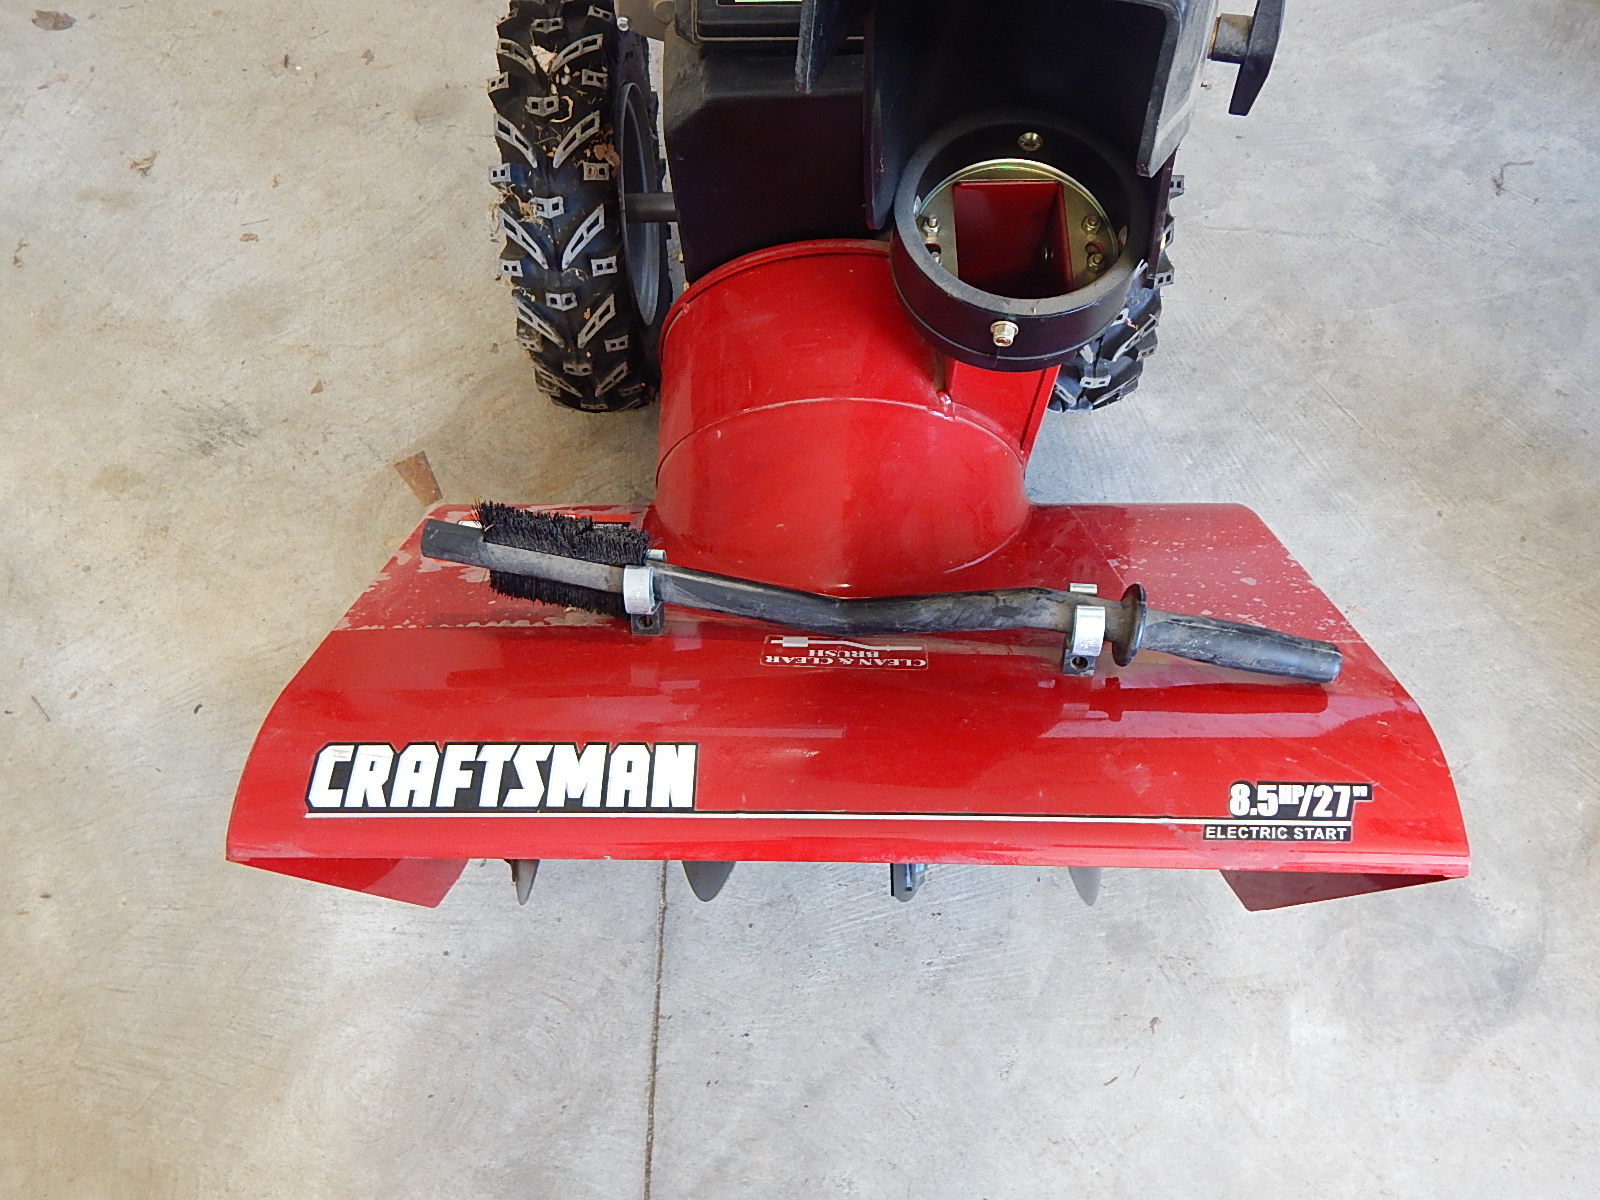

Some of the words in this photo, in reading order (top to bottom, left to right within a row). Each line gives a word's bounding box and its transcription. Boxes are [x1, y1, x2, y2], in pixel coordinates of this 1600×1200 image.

[808, 649, 879, 658] BRUSH
[765, 655, 834, 665] CLEAR
[839, 657, 851, 665] &
[859, 657, 927, 667] CLEAN
[307, 743, 698, 809] CRAFTSMAN
[1205, 825, 1288, 840] ELECTRIC
[1293, 826, 1347, 841] START
